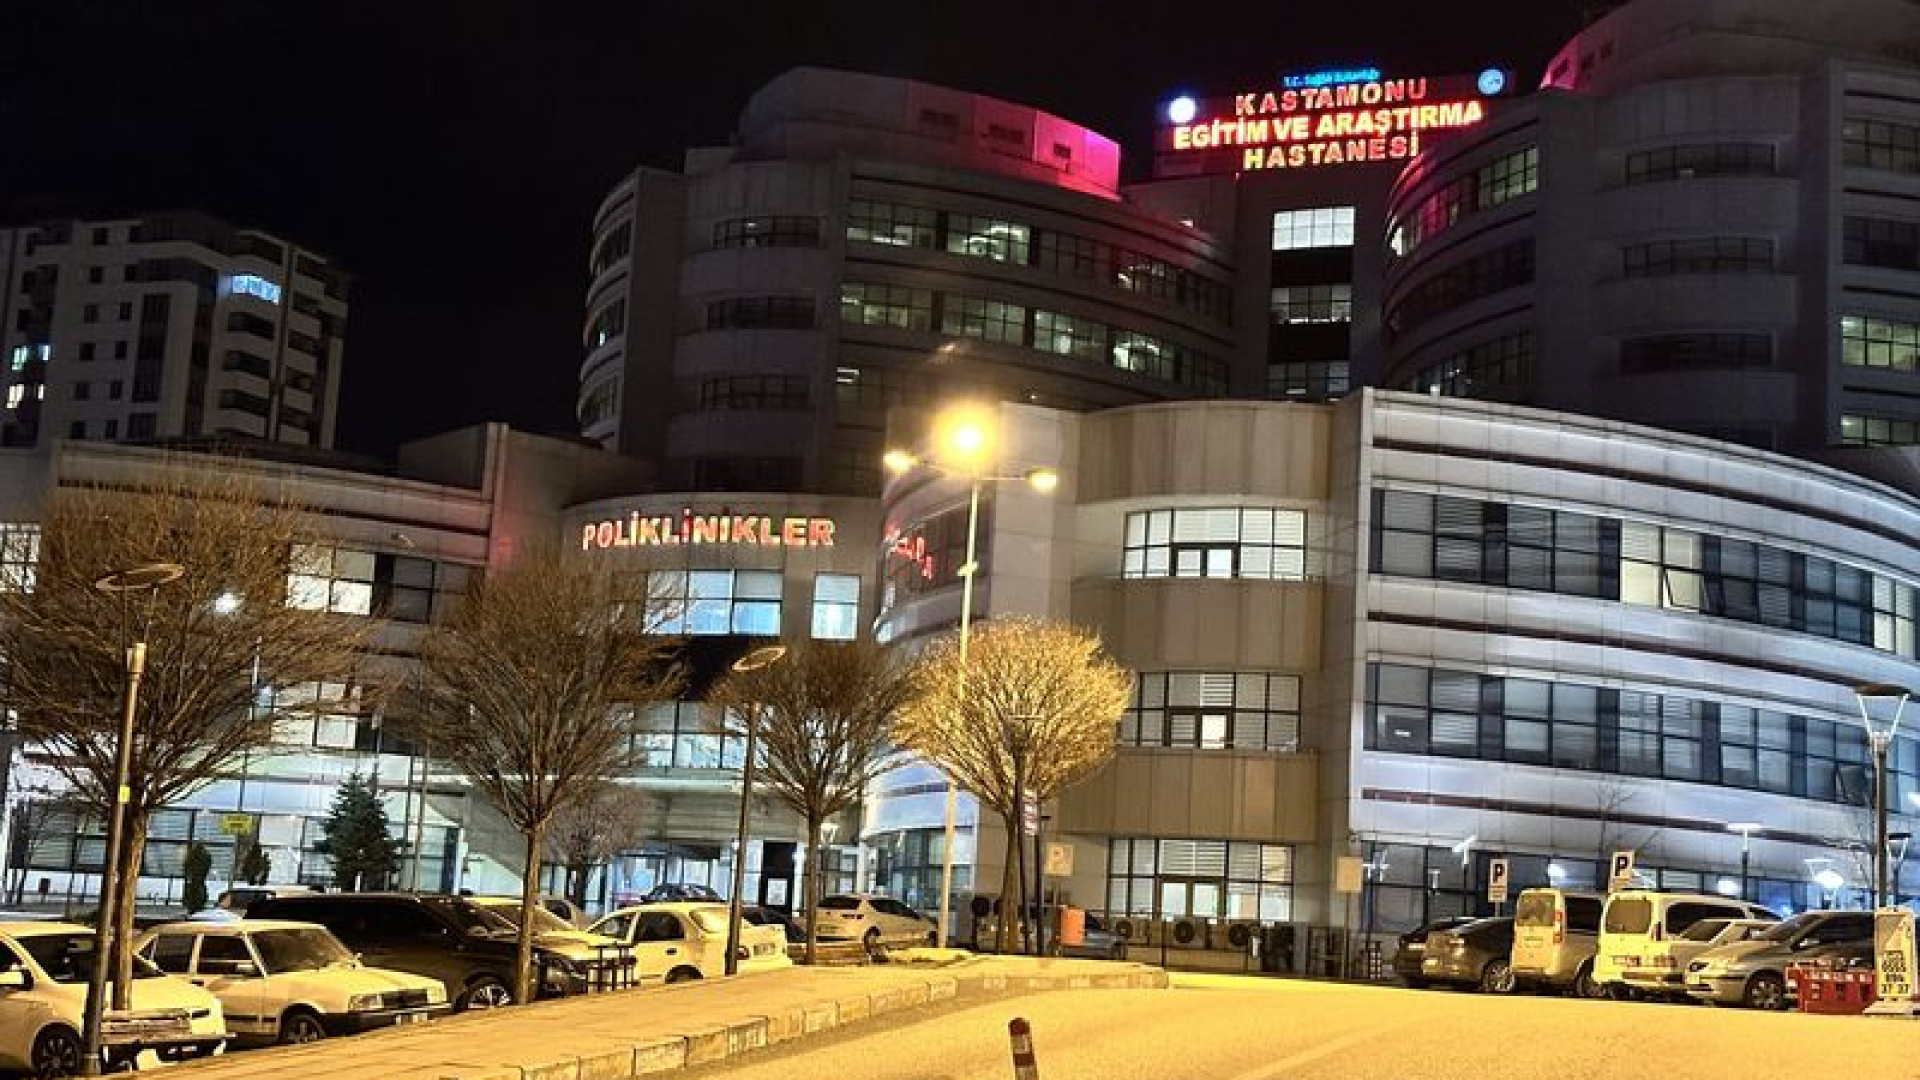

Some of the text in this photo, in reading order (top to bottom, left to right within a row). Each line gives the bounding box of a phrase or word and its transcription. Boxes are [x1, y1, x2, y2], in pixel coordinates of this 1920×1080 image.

[1235, 77, 1426, 115] KASTAMONU
[1272, 115, 1310, 140] VE
[1315, 101, 1482, 136] ARAŞTIRMA
[1243, 131, 1419, 170] HASTANESİ
[1492, 863, 1504, 883] P
[1614, 856, 1628, 876] P
